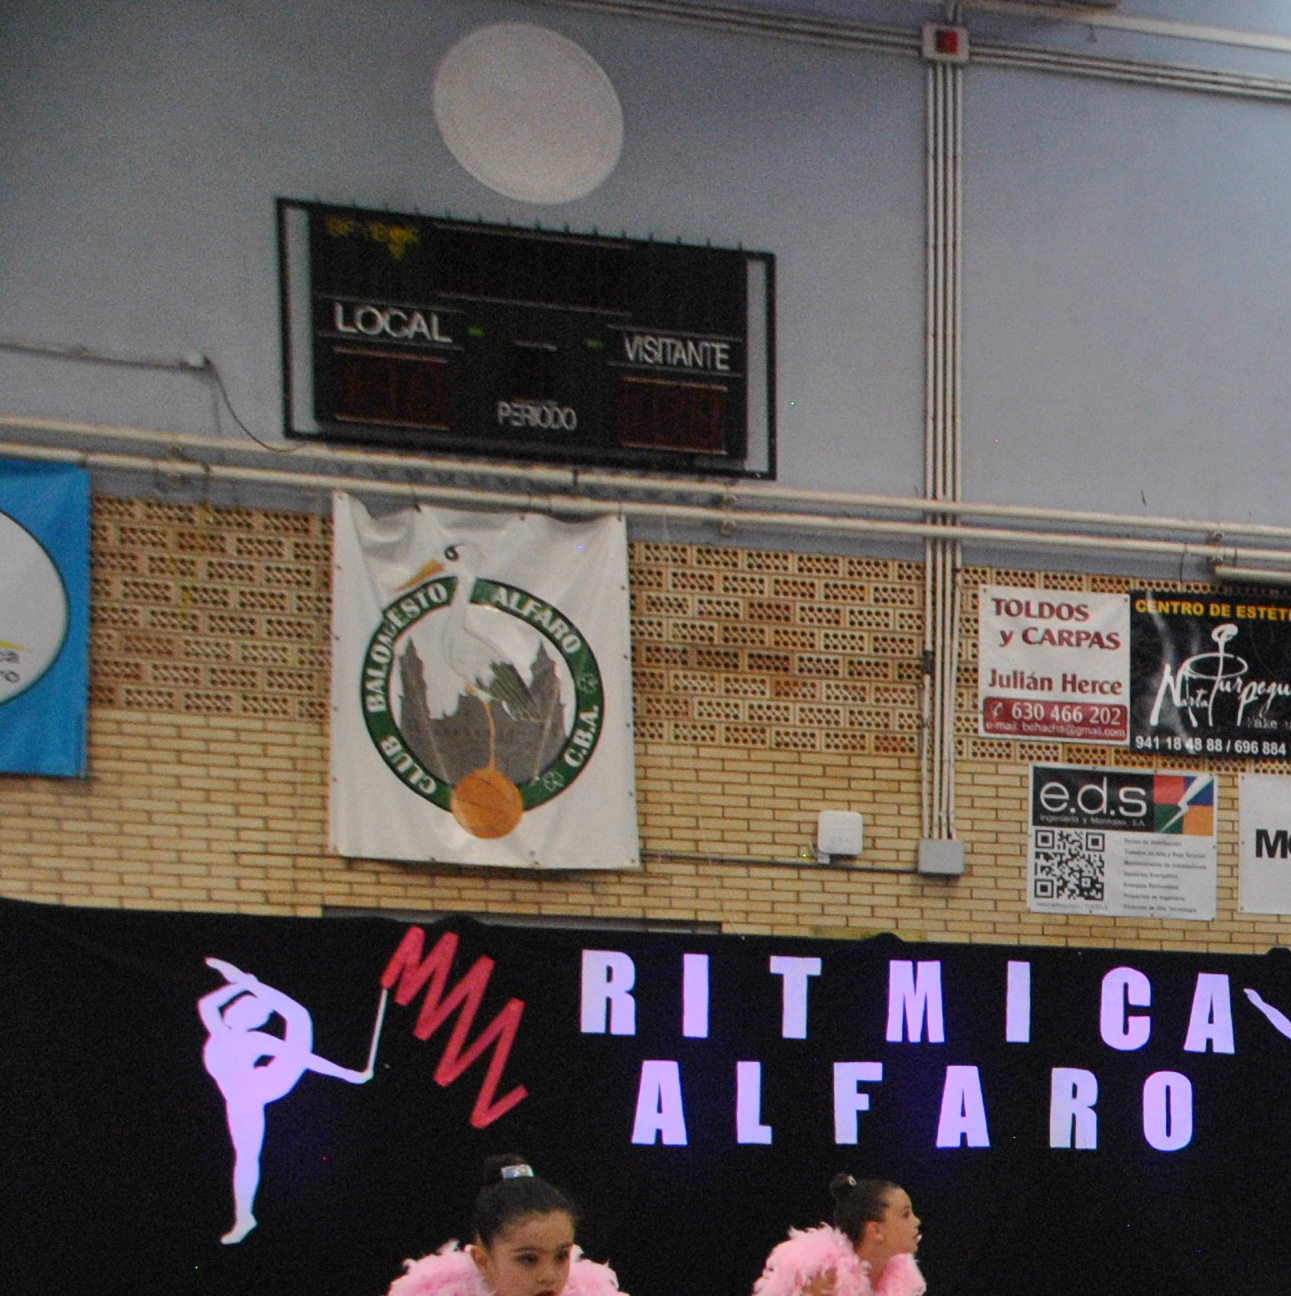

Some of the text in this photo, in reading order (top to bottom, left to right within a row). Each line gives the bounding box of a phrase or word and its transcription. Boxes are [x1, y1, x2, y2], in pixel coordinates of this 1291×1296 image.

[333, 303, 453, 343] LOCAL
[622, 333, 730, 371] VISITANTE
[498, 401, 578, 431] PERIODO
[489, 586, 583, 654] ALFARO
[991, 597, 1090, 622] TOLDOS
[1135, 599, 1204, 615] CENTRO
[1209, 603, 1232, 617] DE
[999, 627, 1121, 650] y CARPAS
[988, 668, 1122, 695] Julián Herce
[1011, 701, 1121, 725] 630 466 202
[563, 704, 599, 768] C.B.A.
[1135, 736, 1160, 750] 941
[1166, 736, 1181, 750] 18
[1206, 738, 1223, 752] 88
[1234, 740, 1258, 754] 696
[1262, 741, 1286, 756] 884
[381, 735, 437, 794] CLUB
[1040, 776, 1147, 818] e.d.s
[579, 949, 1235, 1054] RITMICA
[631, 1060, 1193, 1151] ALFARO
